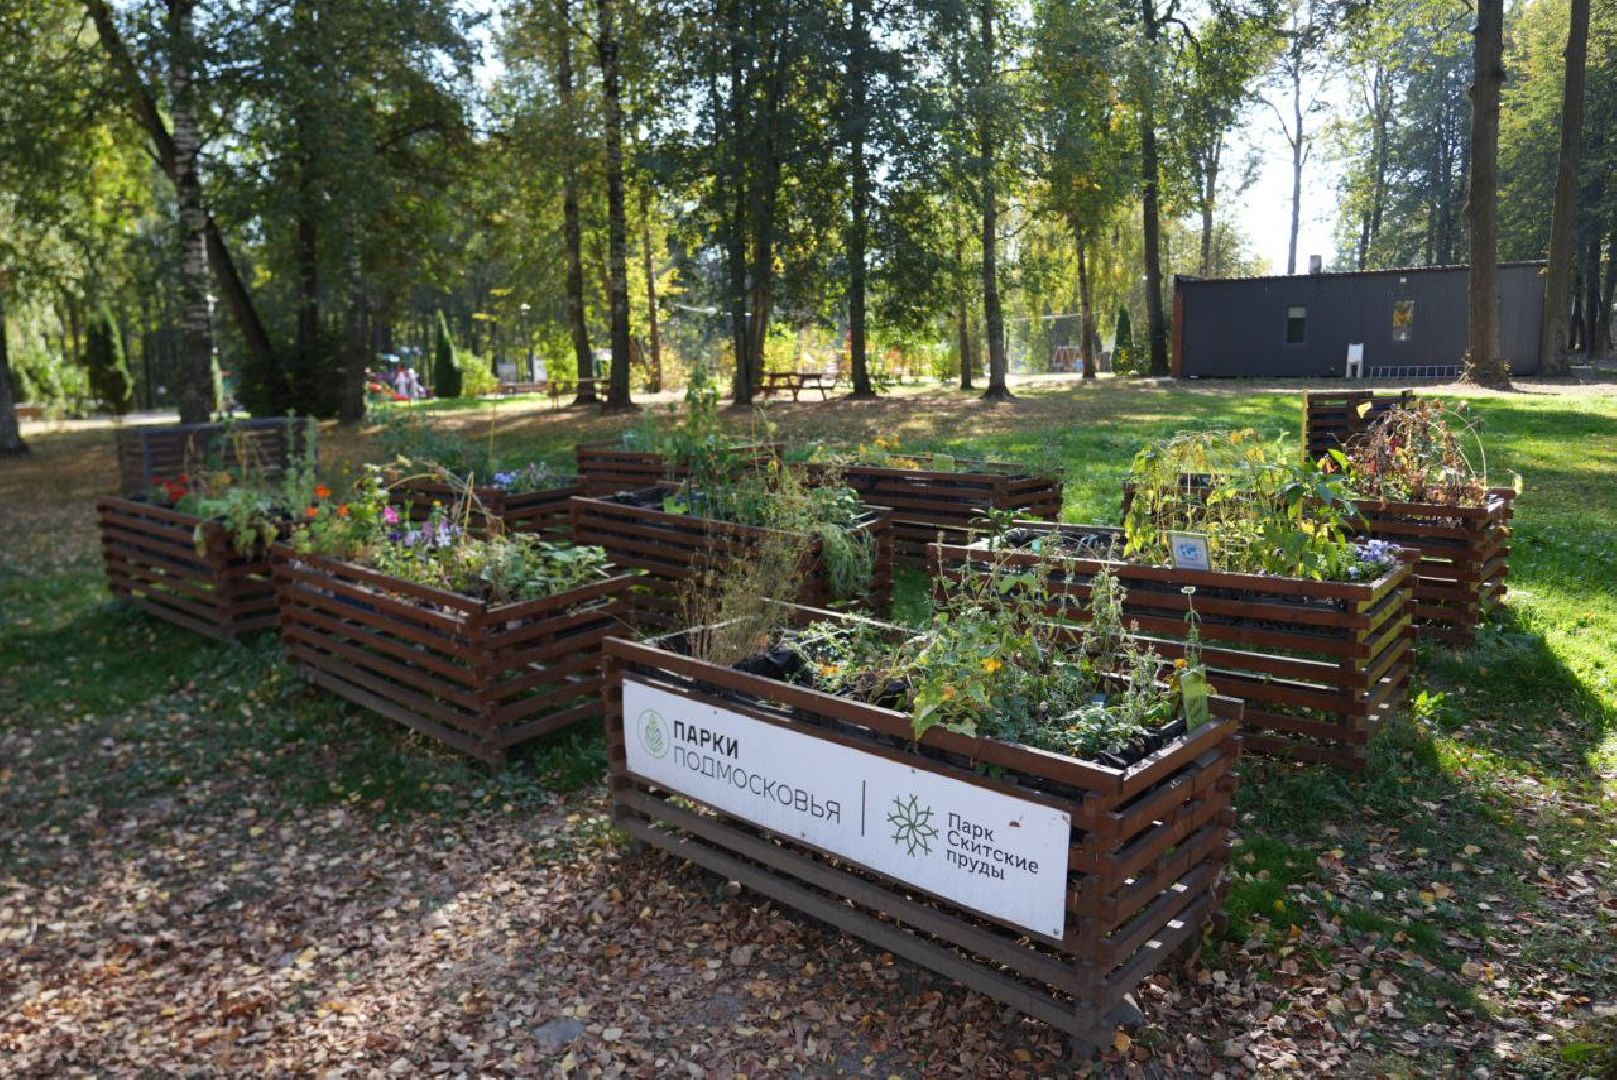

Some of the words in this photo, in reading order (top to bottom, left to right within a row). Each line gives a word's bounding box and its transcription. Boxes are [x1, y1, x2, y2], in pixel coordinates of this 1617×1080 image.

[673, 720, 739, 759] ПАРКИ
[673, 745, 841, 824] ПОДМОСКОВЬЯ
[948, 813, 994, 841] Парк
[947, 850, 1004, 880] пруды
[948, 830, 1039, 874] Скитские
